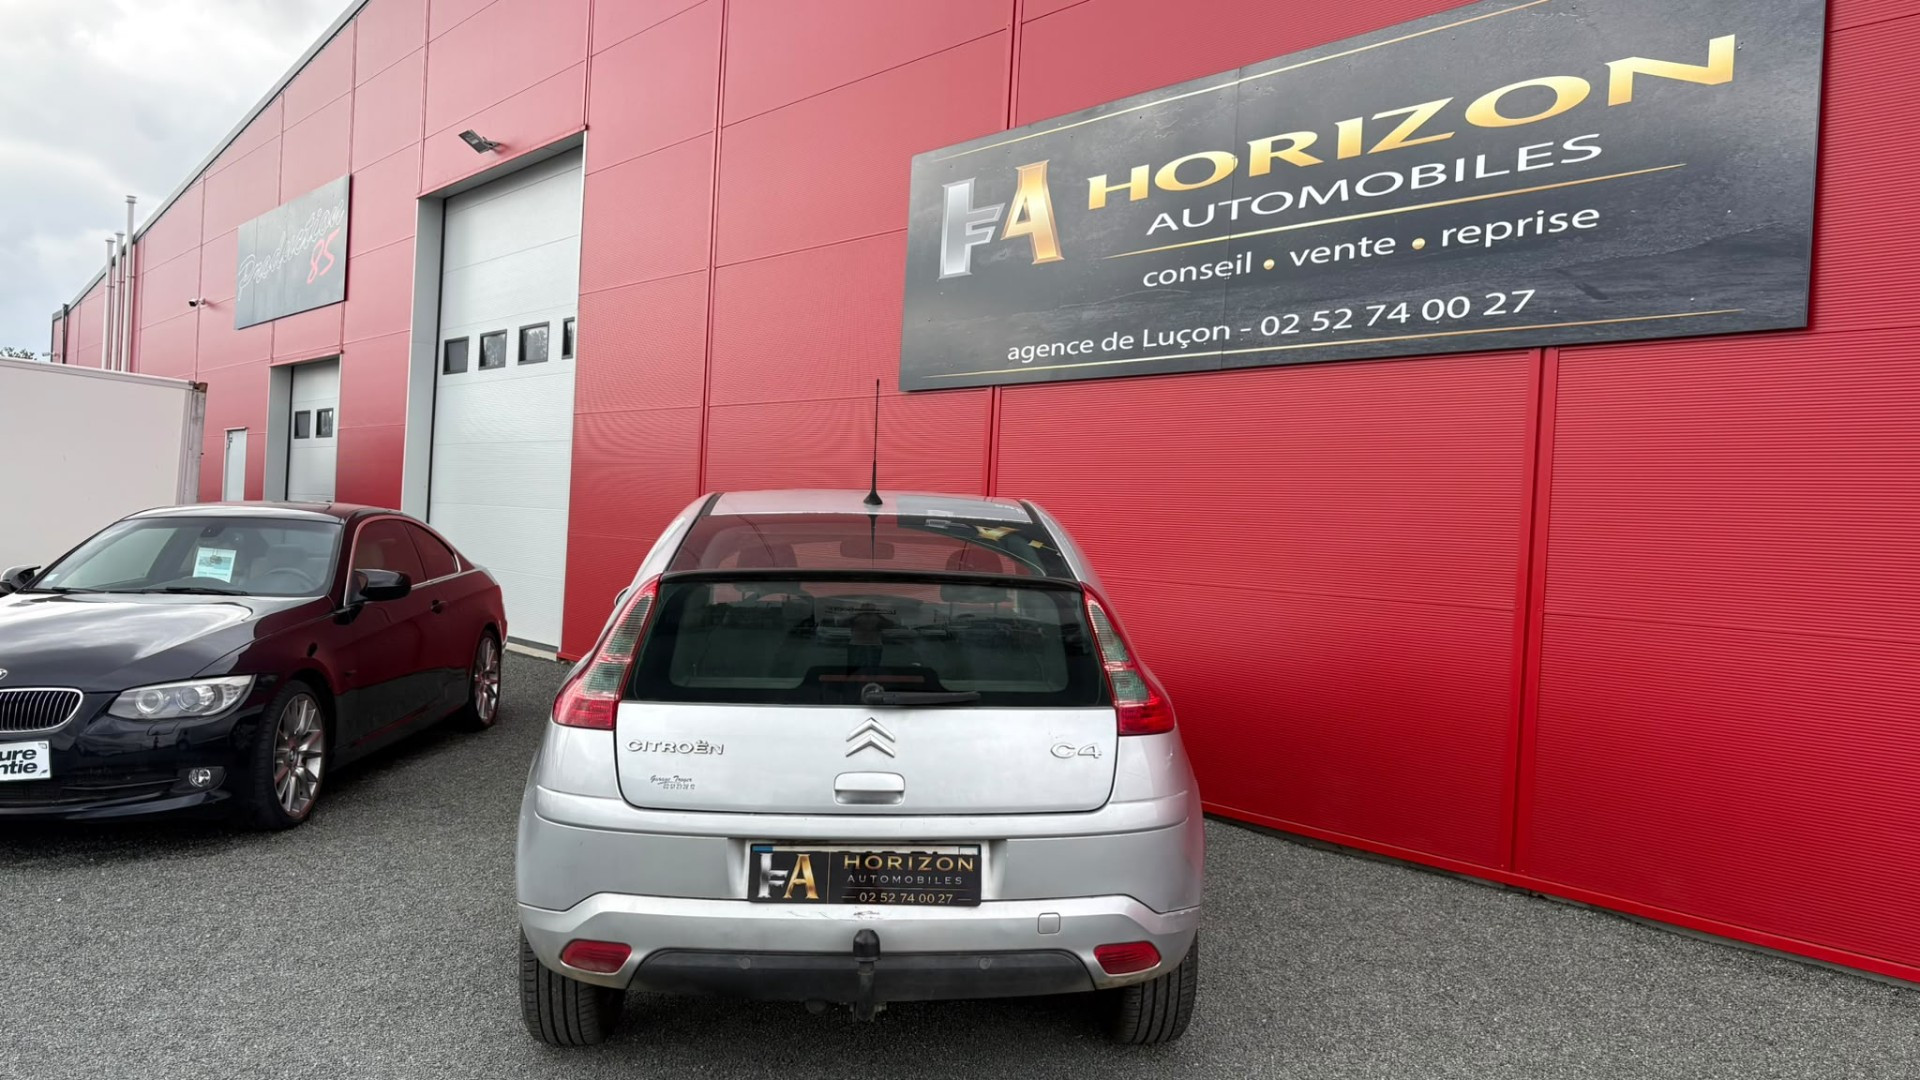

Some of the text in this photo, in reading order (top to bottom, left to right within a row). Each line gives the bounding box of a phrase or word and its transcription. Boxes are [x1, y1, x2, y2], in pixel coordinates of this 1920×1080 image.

[1087, 34, 1736, 211] HORIZON
[1146, 133, 1603, 236] AUTOMOBILES
[306, 226, 341, 285] 85
[1142, 208, 1600, 288] conseil vente reprise
[1007, 337, 1094, 364] agence
[1101, 331, 1135, 352] de
[1143, 321, 1231, 349] Luçon
[1260, 314, 1300, 337] 02
[1310, 308, 1353, 332] 52
[1366, 302, 1411, 327] 74
[1421, 295, 1471, 321] 00
[1482, 289, 1536, 316] 27
[625, 739, 725, 755] CITROËN
[1049, 741, 1103, 760] C4
[843, 855, 974, 872] HORIZON
[847, 874, 962, 885] AUTOMOBILES
[859, 892, 953, 904] 02 52 74 00 27
